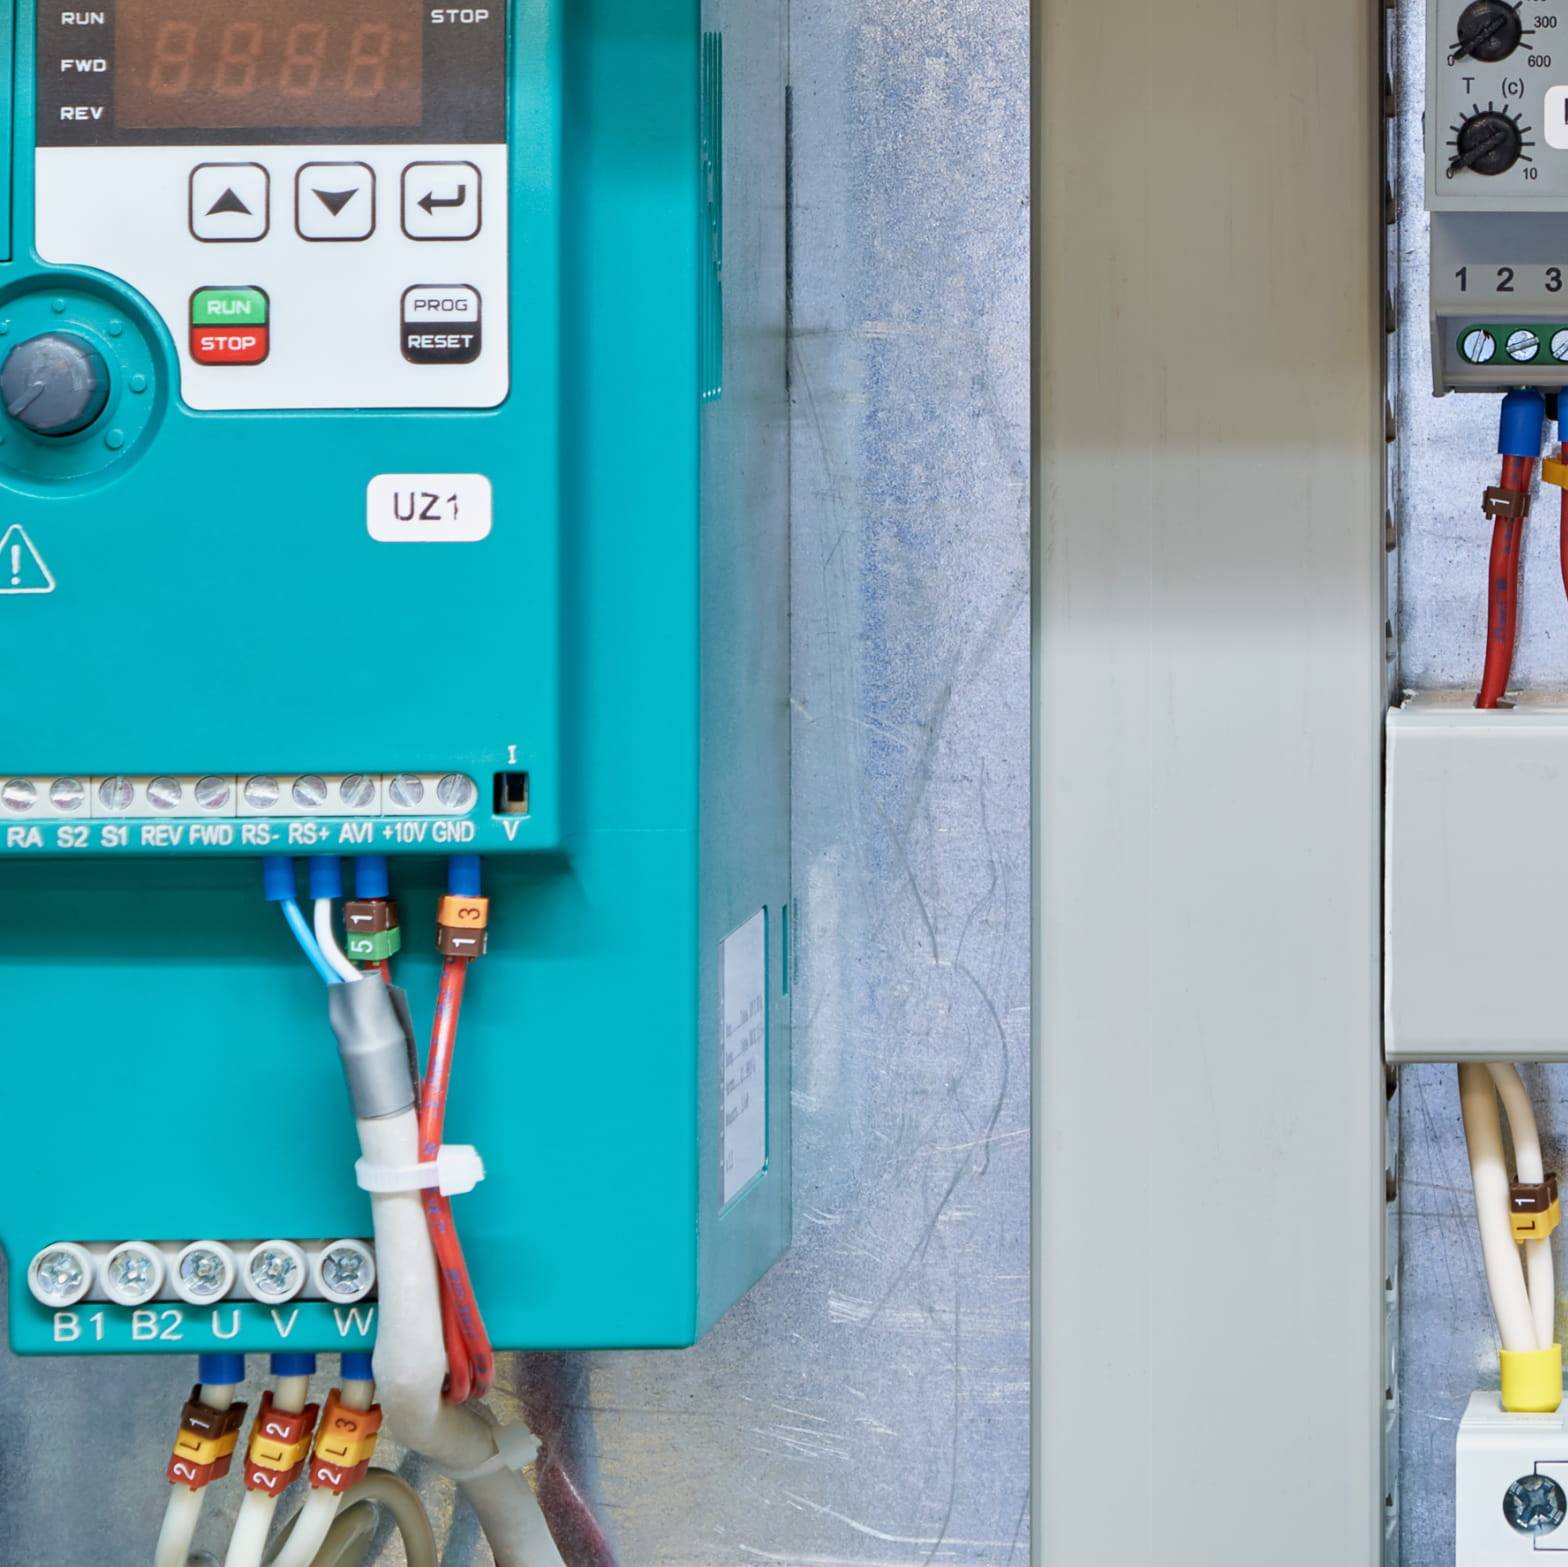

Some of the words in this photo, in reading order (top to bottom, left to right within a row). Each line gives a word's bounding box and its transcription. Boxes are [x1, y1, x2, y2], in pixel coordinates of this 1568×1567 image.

[61, 11, 105, 26] RUN
[431, 8, 489, 24] STOP
[1534, 16, 1558, 29] 300
[61, 58, 107, 73] FWD
[1528, 55, 1552, 68] 600
[1462, 77, 1475, 95] T
[1502, 78, 1525, 98] (c)
[60, 106, 104, 121] REV
[1523, 168, 1538, 180] 10
[1455, 266, 1468, 291] 1
[1496, 266, 1514, 292] 2
[1545, 267, 1562, 292] 3
[207, 300, 251, 315] RUN
[414, 298, 468, 314] PROG
[201, 335, 256, 350] STOP
[408, 334, 474, 349] RESET
[393, 491, 461, 522] UZ1
[6, 826, 44, 848] RA
[57, 826, 89, 848] S2
[101, 826, 128, 847] S1
[141, 825, 183, 846] REV
[189, 824, 233, 846] FWD
[288, 822, 330, 844] RS+
[338, 822, 373, 843] AVI
[382, 821, 427, 843] +10V
[432, 821, 475, 842] GND
[132, 1310, 183, 1341] B2
[211, 1309, 241, 1339] U
[271, 1309, 298, 1338] V
[333, 1308, 375, 1336] W
